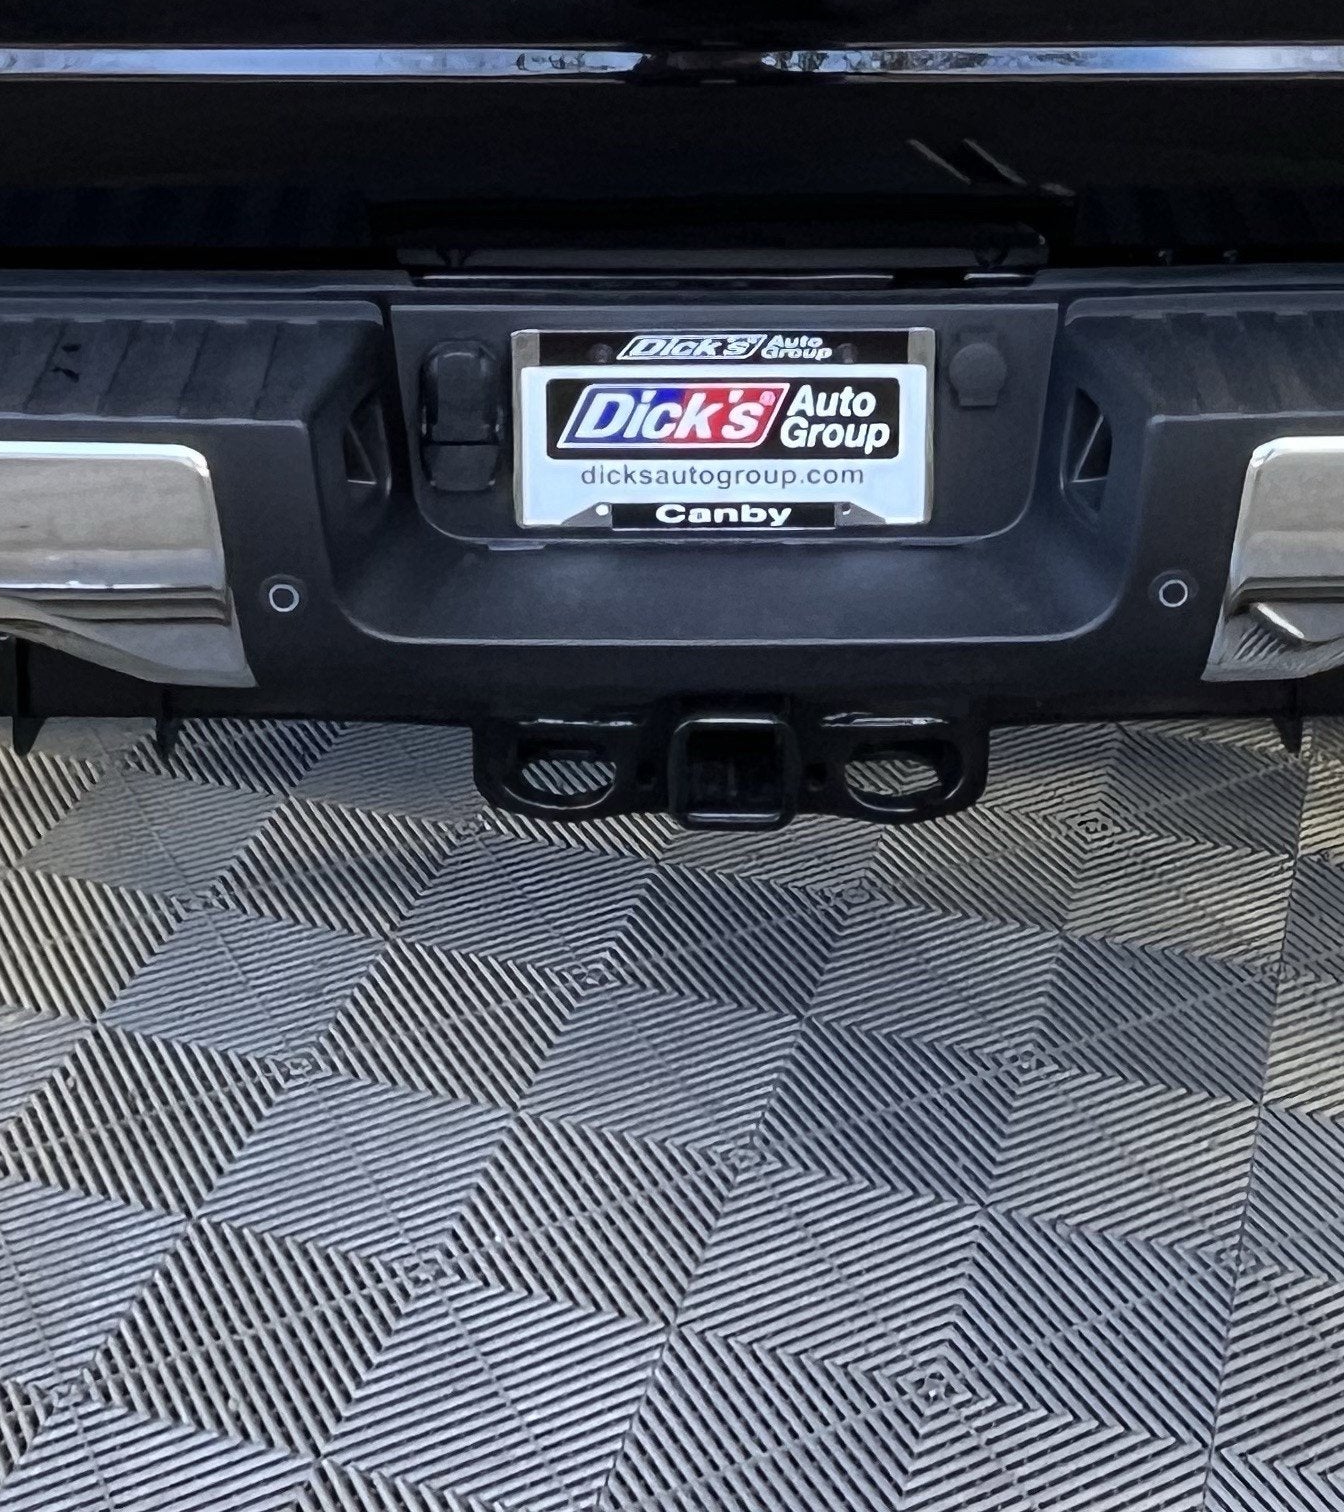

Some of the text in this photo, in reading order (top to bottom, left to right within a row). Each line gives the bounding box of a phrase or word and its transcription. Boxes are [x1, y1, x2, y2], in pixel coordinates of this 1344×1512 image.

[761, 346, 833, 361] Group
[768, 335, 824, 349] Auto
[575, 384, 877, 439] Dick's Auto
[780, 416, 891, 455] Group
[581, 464, 864, 489] dicksautogroup.com
[656, 504, 792, 526] Canby
